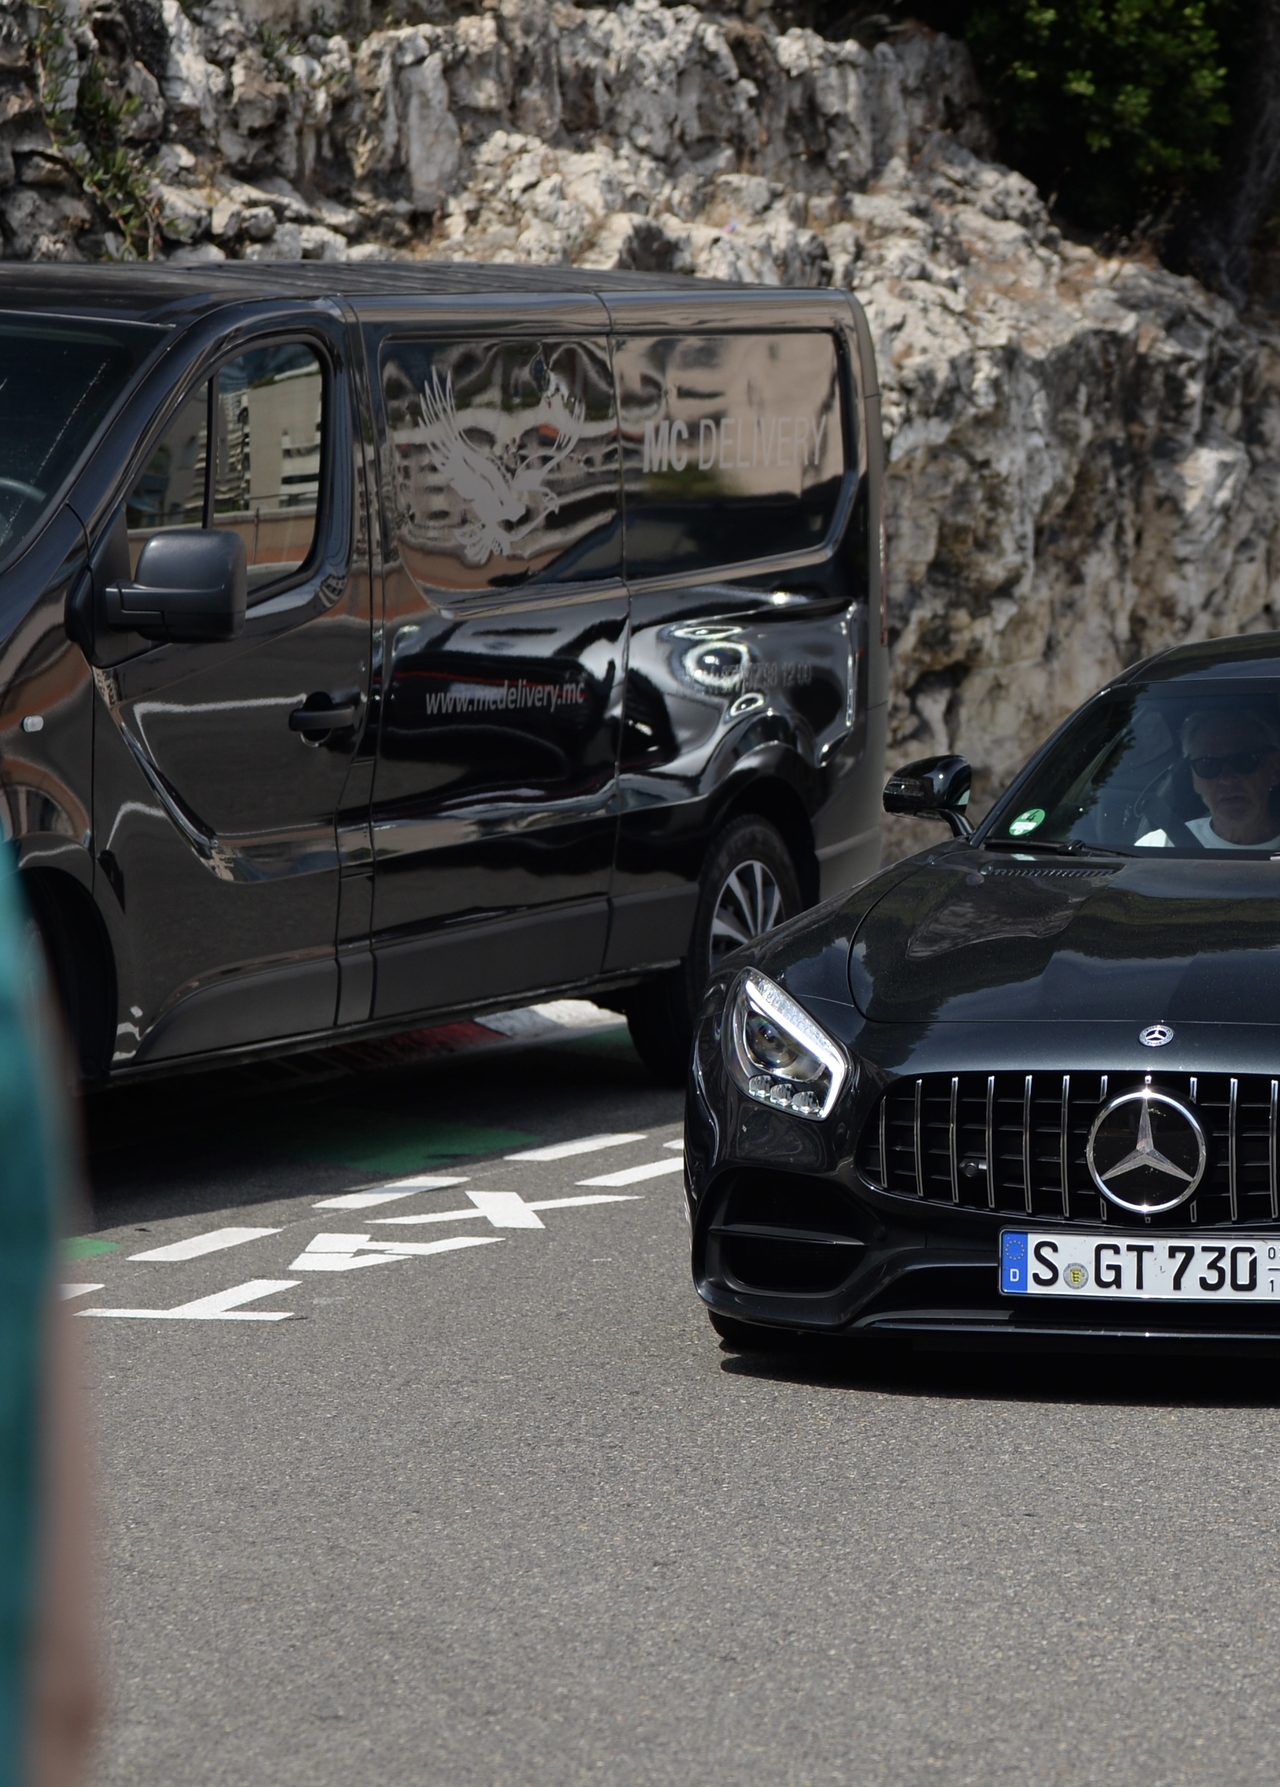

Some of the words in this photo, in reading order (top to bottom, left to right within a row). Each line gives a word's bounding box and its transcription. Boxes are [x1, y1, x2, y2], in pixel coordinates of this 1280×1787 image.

[642, 418, 689, 473] MC
[698, 414, 827, 470] DELIVERY
[425, 678, 585, 715] www.mcdelivery.mc
[1009, 1268, 1020, 1282] D
[1031, 1240, 1060, 1287] S
[1094, 1243, 1155, 1290] GT
[1167, 1245, 1258, 1292] 730
